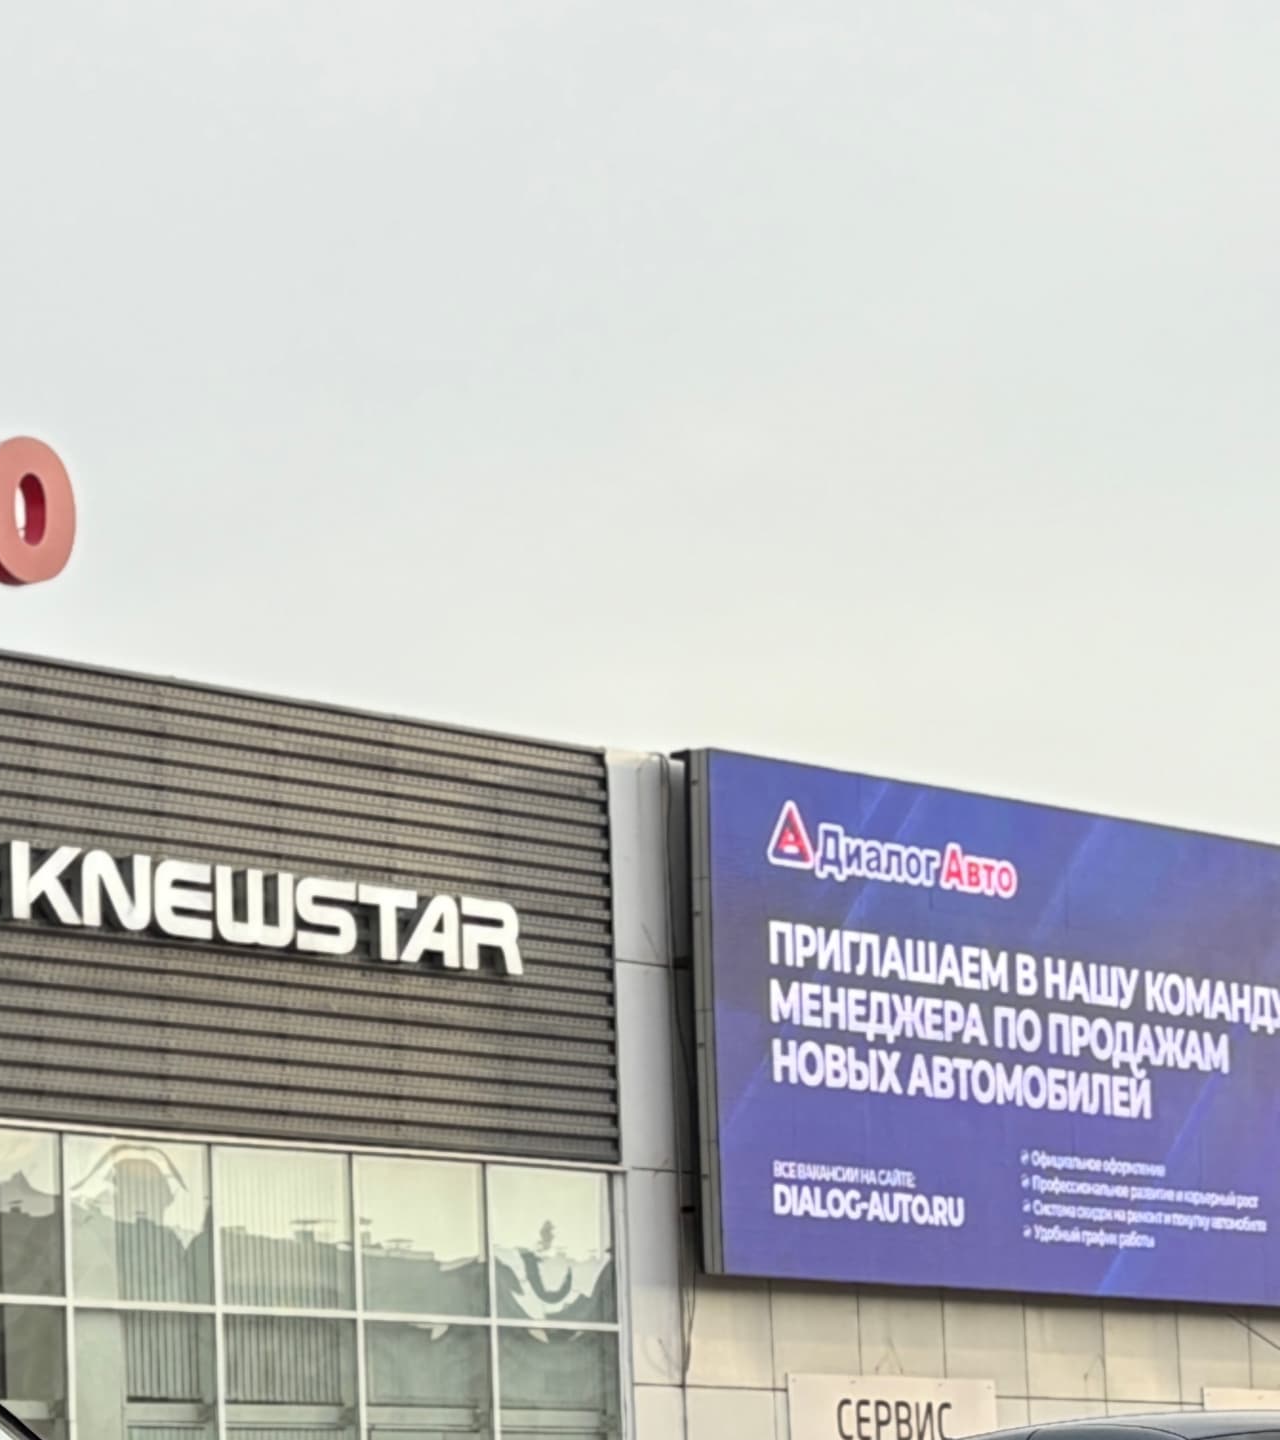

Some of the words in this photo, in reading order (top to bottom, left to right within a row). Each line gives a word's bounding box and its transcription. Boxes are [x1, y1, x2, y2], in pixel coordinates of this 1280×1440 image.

[9, 840, 524, 975] KNEWSTAR
[769, 920, 1008, 994] ПРИГЛАШАЕМ
[1015, 953, 1038, 996] В
[1044, 957, 1139, 1009] НАШУ
[769, 978, 988, 1045] МЕНЕДЖЕРА
[994, 1006, 1042, 1052] ПО
[1048, 1012, 1229, 1074] ПРОДАЖАМ
[772, 1037, 903, 1095] НОВЫХ
[907, 1054, 1152, 1120] АВТОМОБИЛЕЙ
[773, 1160, 796, 1179] ВСЕ
[798, 1163, 859, 1184] ВАКАНСИИ
[860, 1167, 877, 1185] НА
[773, 1183, 964, 1227] DIALOG-AUTO.RU
